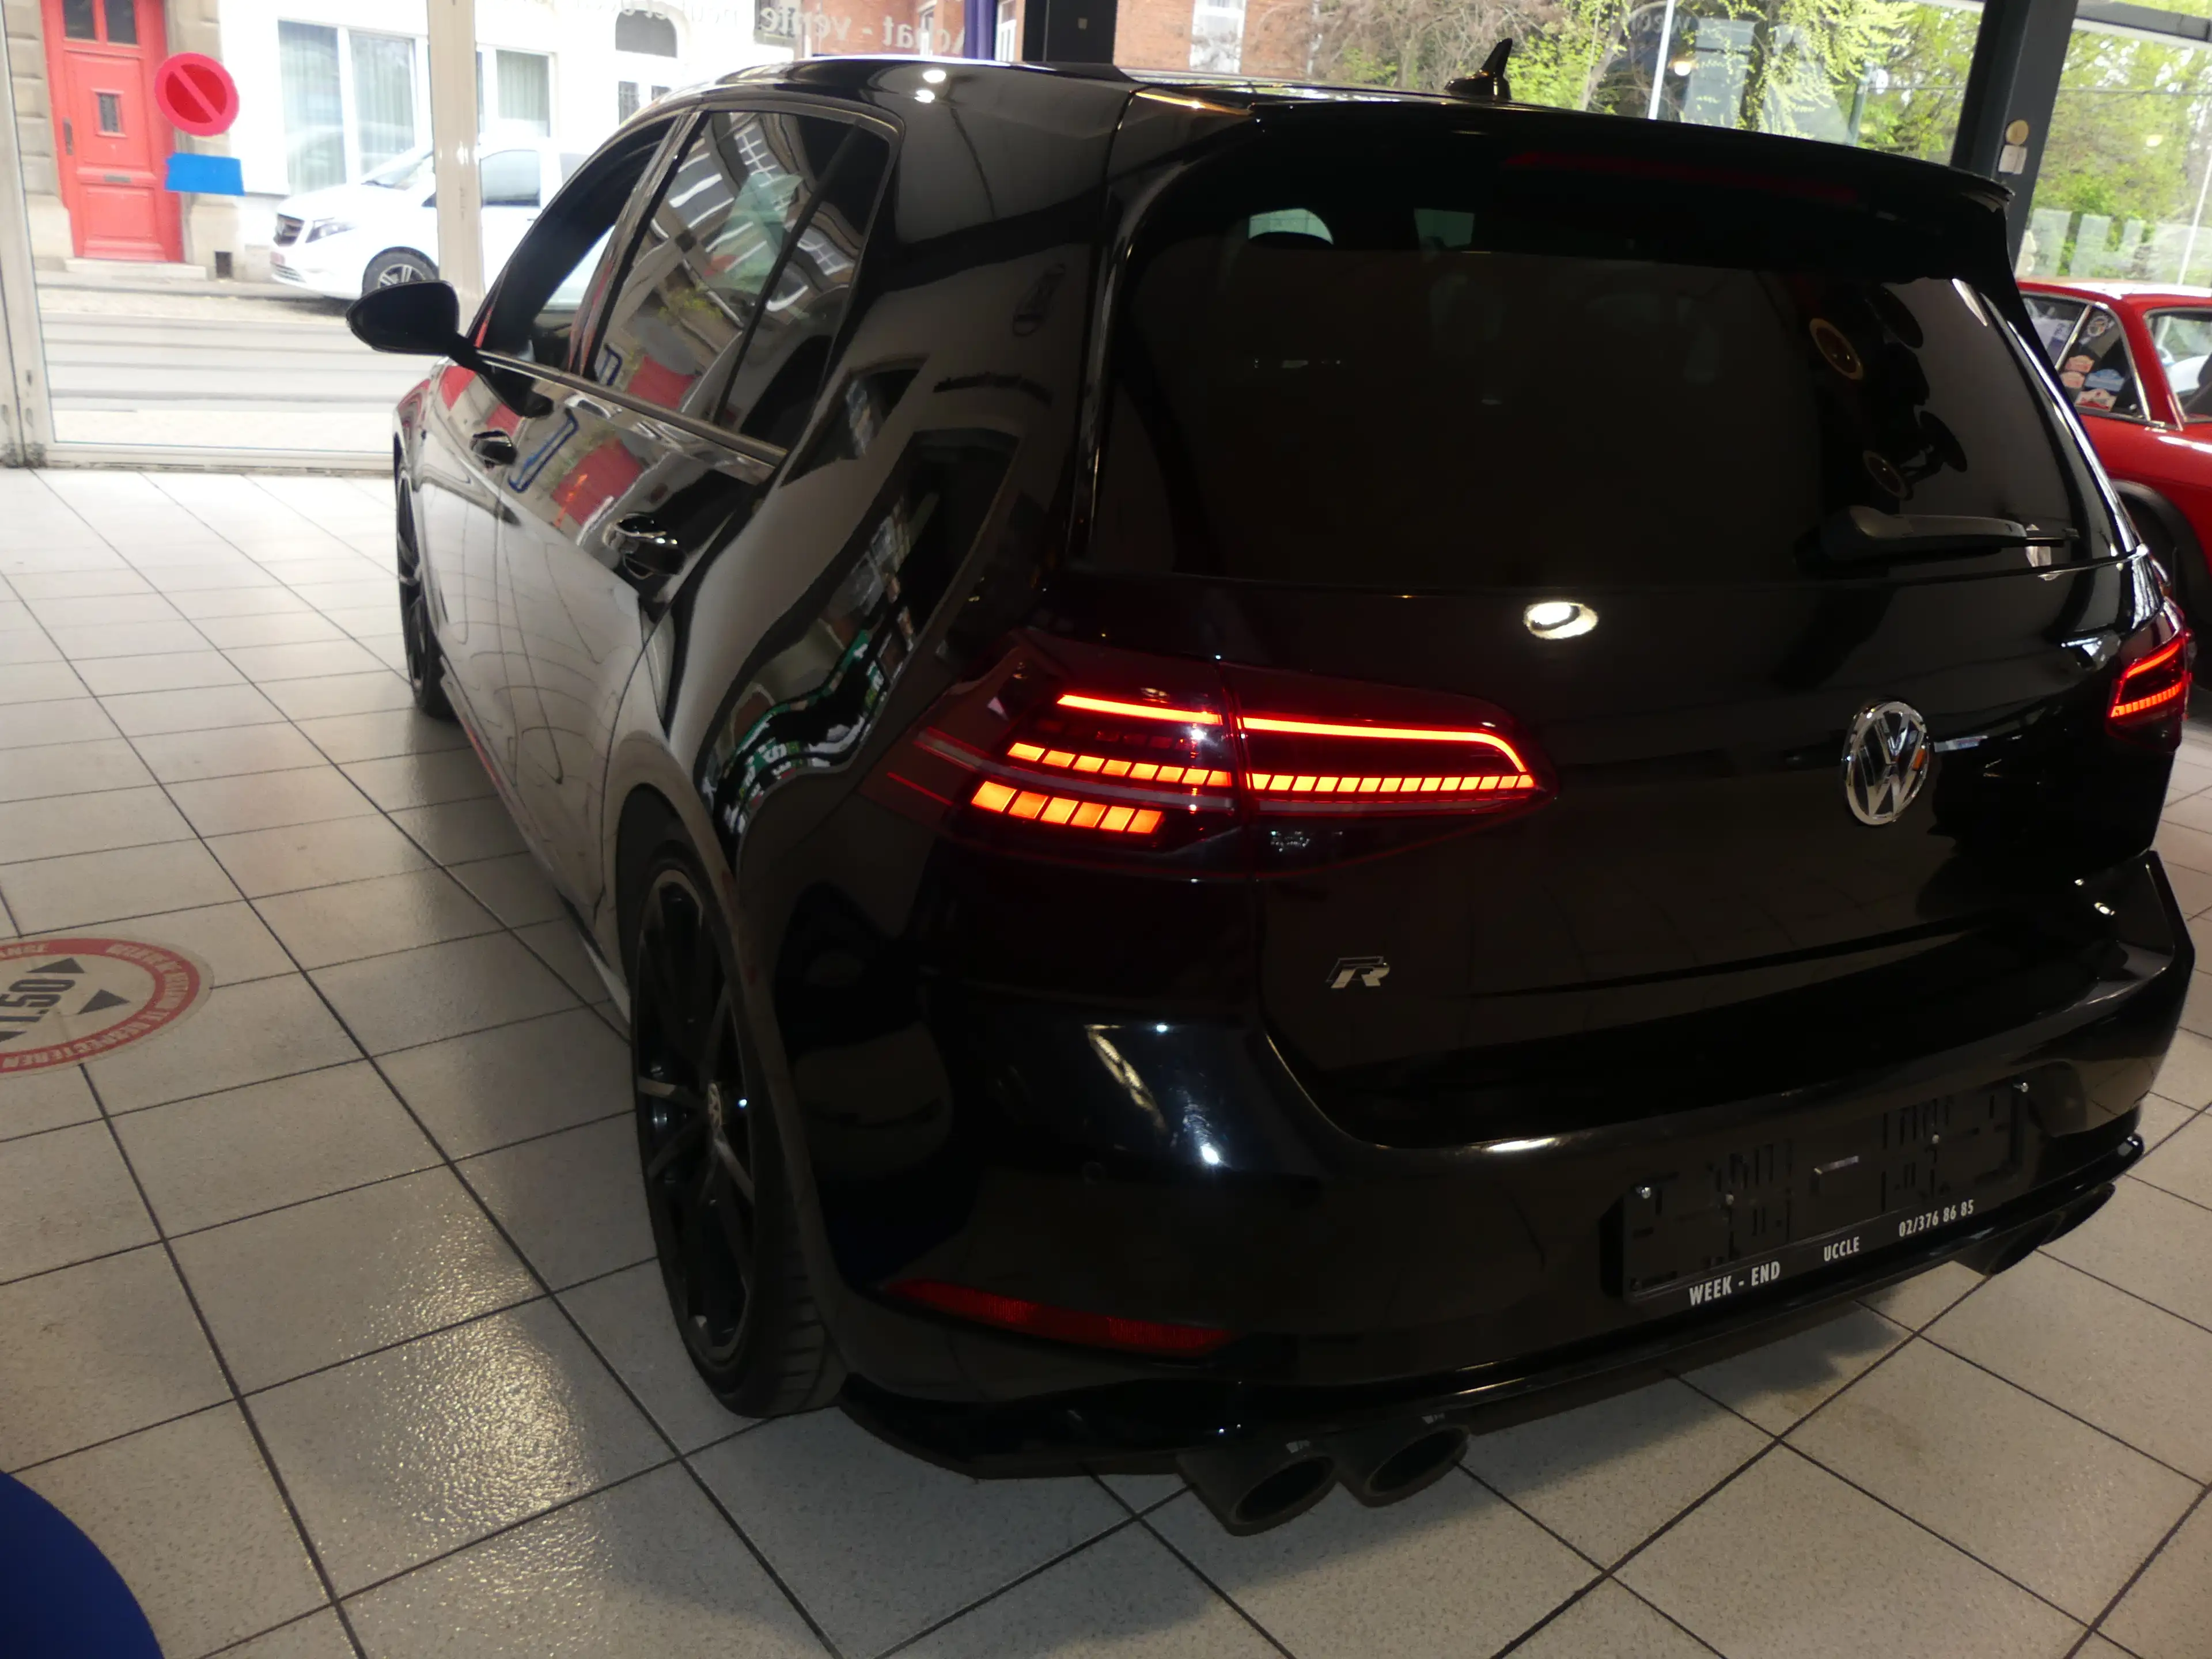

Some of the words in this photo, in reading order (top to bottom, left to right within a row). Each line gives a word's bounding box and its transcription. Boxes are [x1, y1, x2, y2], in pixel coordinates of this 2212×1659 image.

[1325, 956, 1390, 989] R
[1689, 1275, 1732, 1306] WEEK
[1751, 1261, 1780, 1286] END
[1823, 1236, 1859, 1262] UCCLE
[1899, 1210, 1939, 1237] 02/376
[1942, 1205, 1957, 1222] 86
[1960, 1199, 1974, 1217] 85
